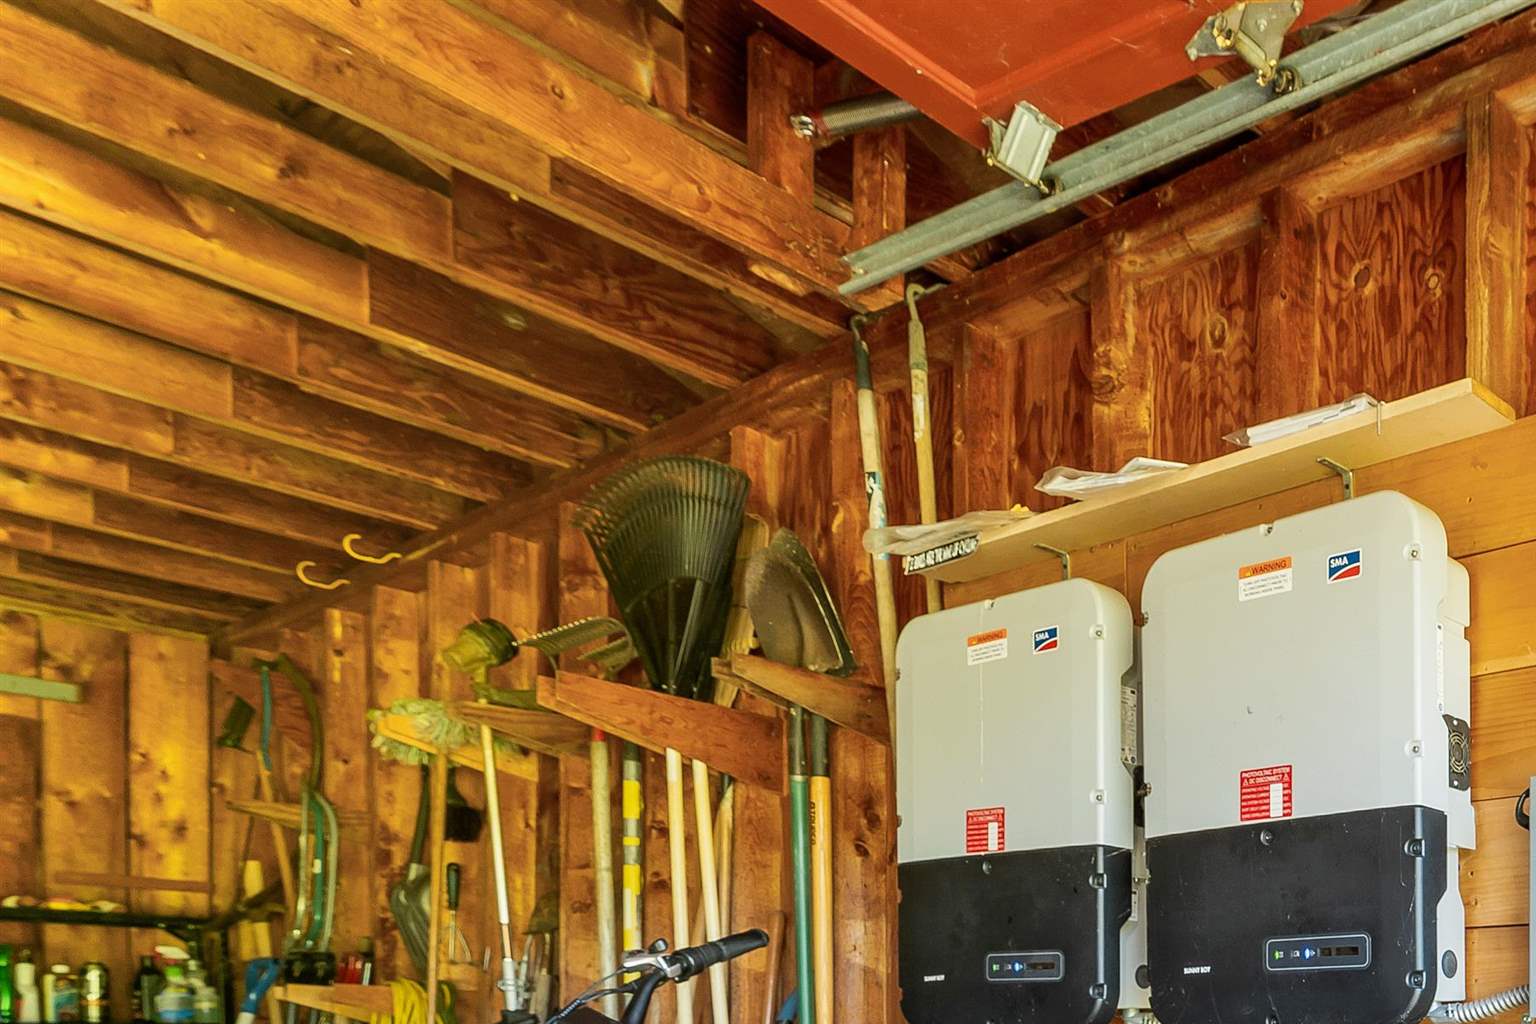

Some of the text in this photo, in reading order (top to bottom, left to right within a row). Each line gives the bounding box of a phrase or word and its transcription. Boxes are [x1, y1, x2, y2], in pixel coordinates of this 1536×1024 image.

[1251, 559, 1288, 575] WARNING
[1329, 555, 1350, 569] SMA
[1035, 631, 1050, 642] SMA
